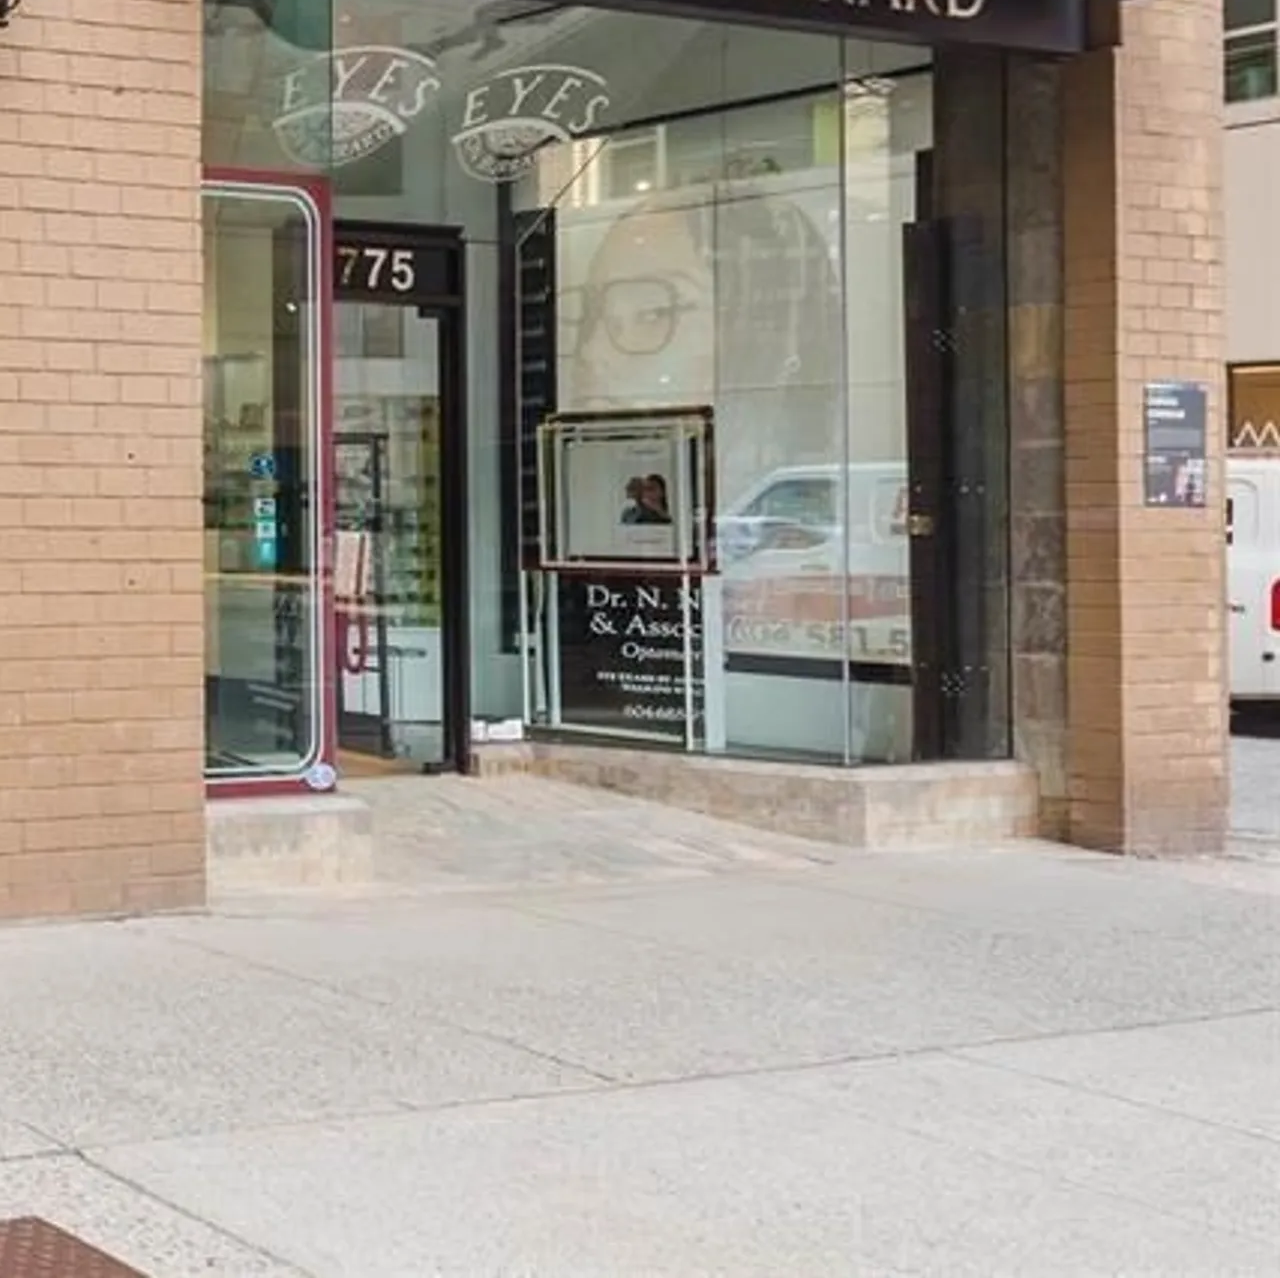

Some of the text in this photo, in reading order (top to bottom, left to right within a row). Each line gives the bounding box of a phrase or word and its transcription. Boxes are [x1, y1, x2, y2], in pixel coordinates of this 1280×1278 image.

[283, 56, 439, 118] EYES
[462, 75, 609, 132] EYES
[338, 246, 415, 291] 775
[587, 585, 627, 608] Dr.
[636, 586, 668, 610] N.
[590, 612, 618, 635] &
